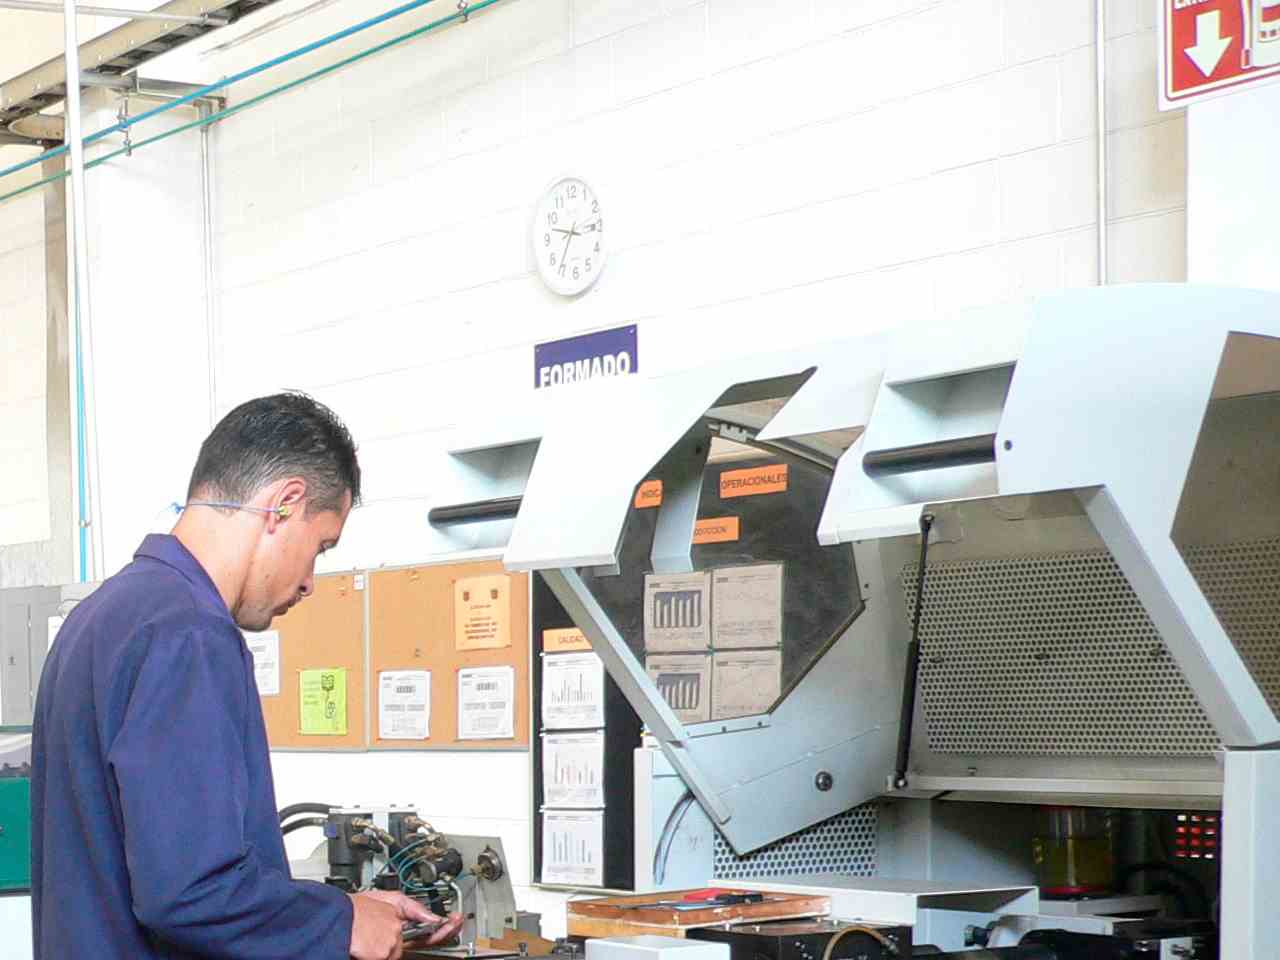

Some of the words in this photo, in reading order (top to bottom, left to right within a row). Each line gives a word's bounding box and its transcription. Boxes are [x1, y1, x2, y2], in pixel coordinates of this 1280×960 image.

[567, 184, 577, 199] 12
[555, 196, 564, 209] 11
[591, 199, 600, 214] 2
[546, 211, 558, 225] 10
[585, 257, 592, 272] 5
[572, 265, 580, 281] 6
[540, 351, 631, 388] FORMADO
